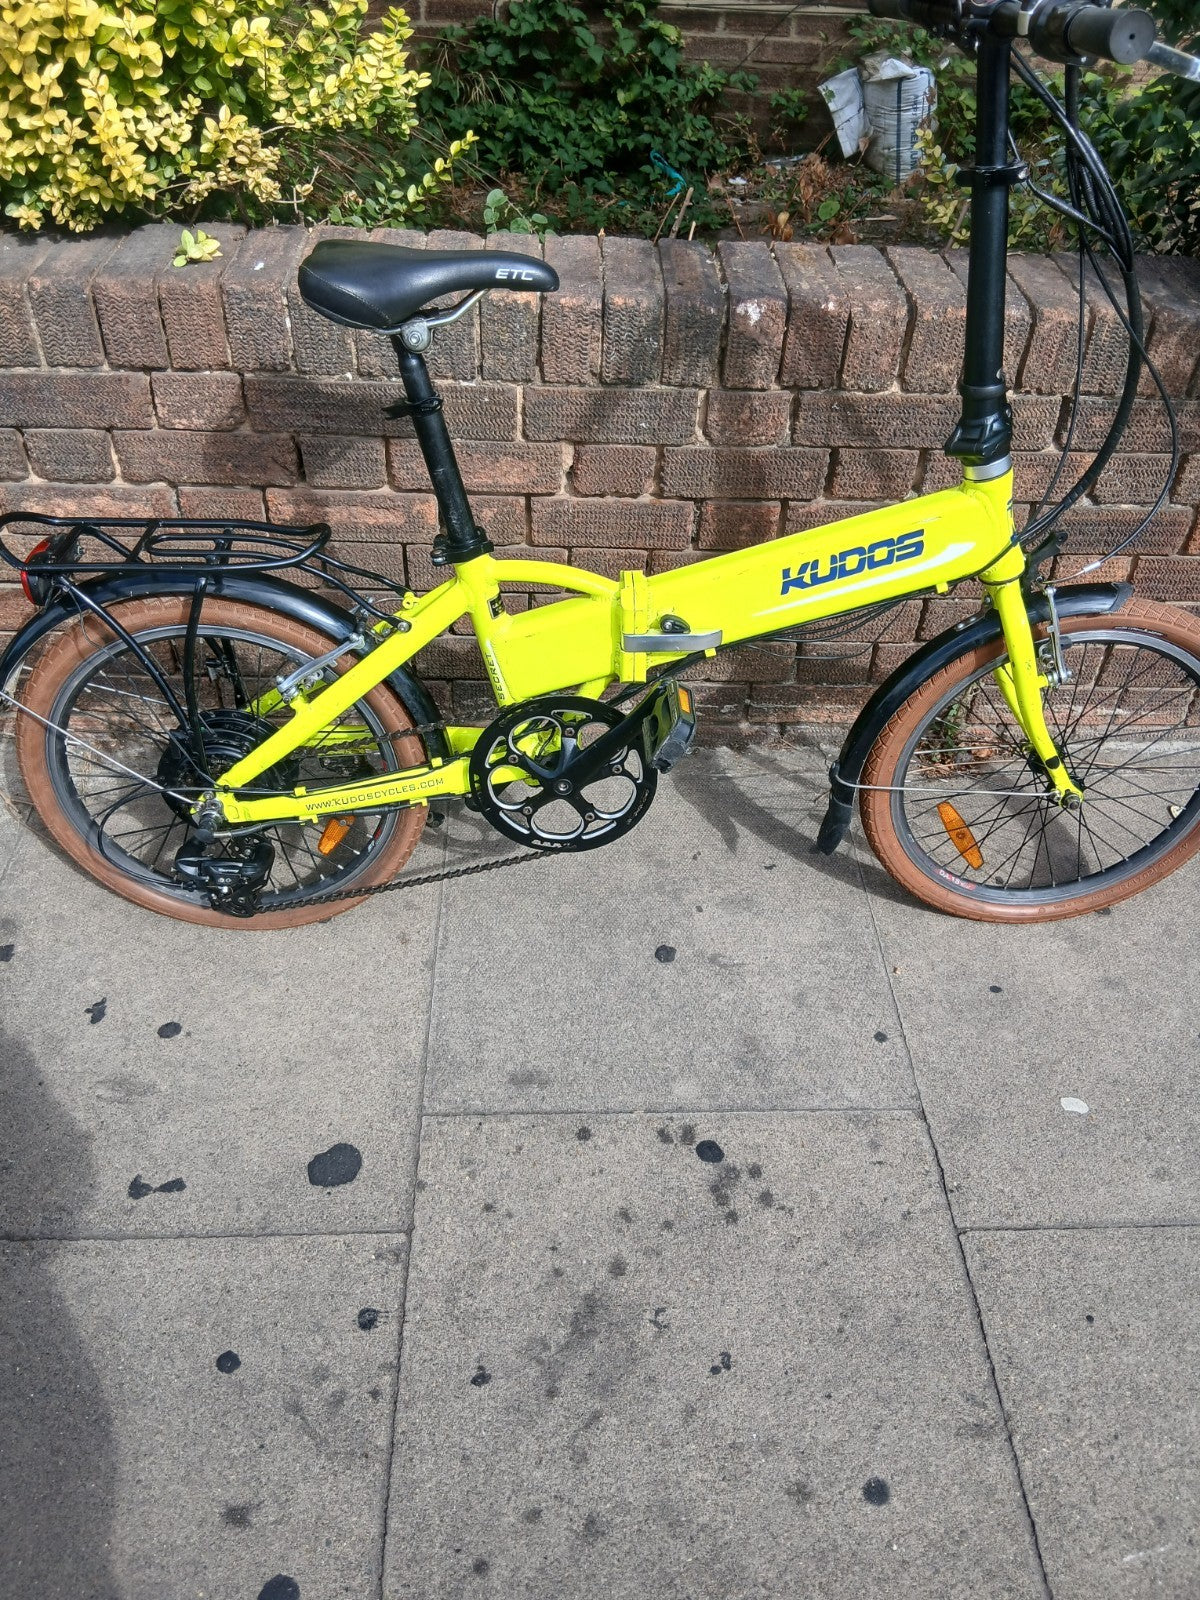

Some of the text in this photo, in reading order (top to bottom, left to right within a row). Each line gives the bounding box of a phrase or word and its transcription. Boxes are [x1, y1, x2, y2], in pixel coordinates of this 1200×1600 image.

[495, 268, 538, 281] ETC
[780, 528, 925, 595] KUDOS
[485, 651, 506, 700] SECRET
[305, 777, 444, 811] WWW.KUDOSCYCLES.COM
